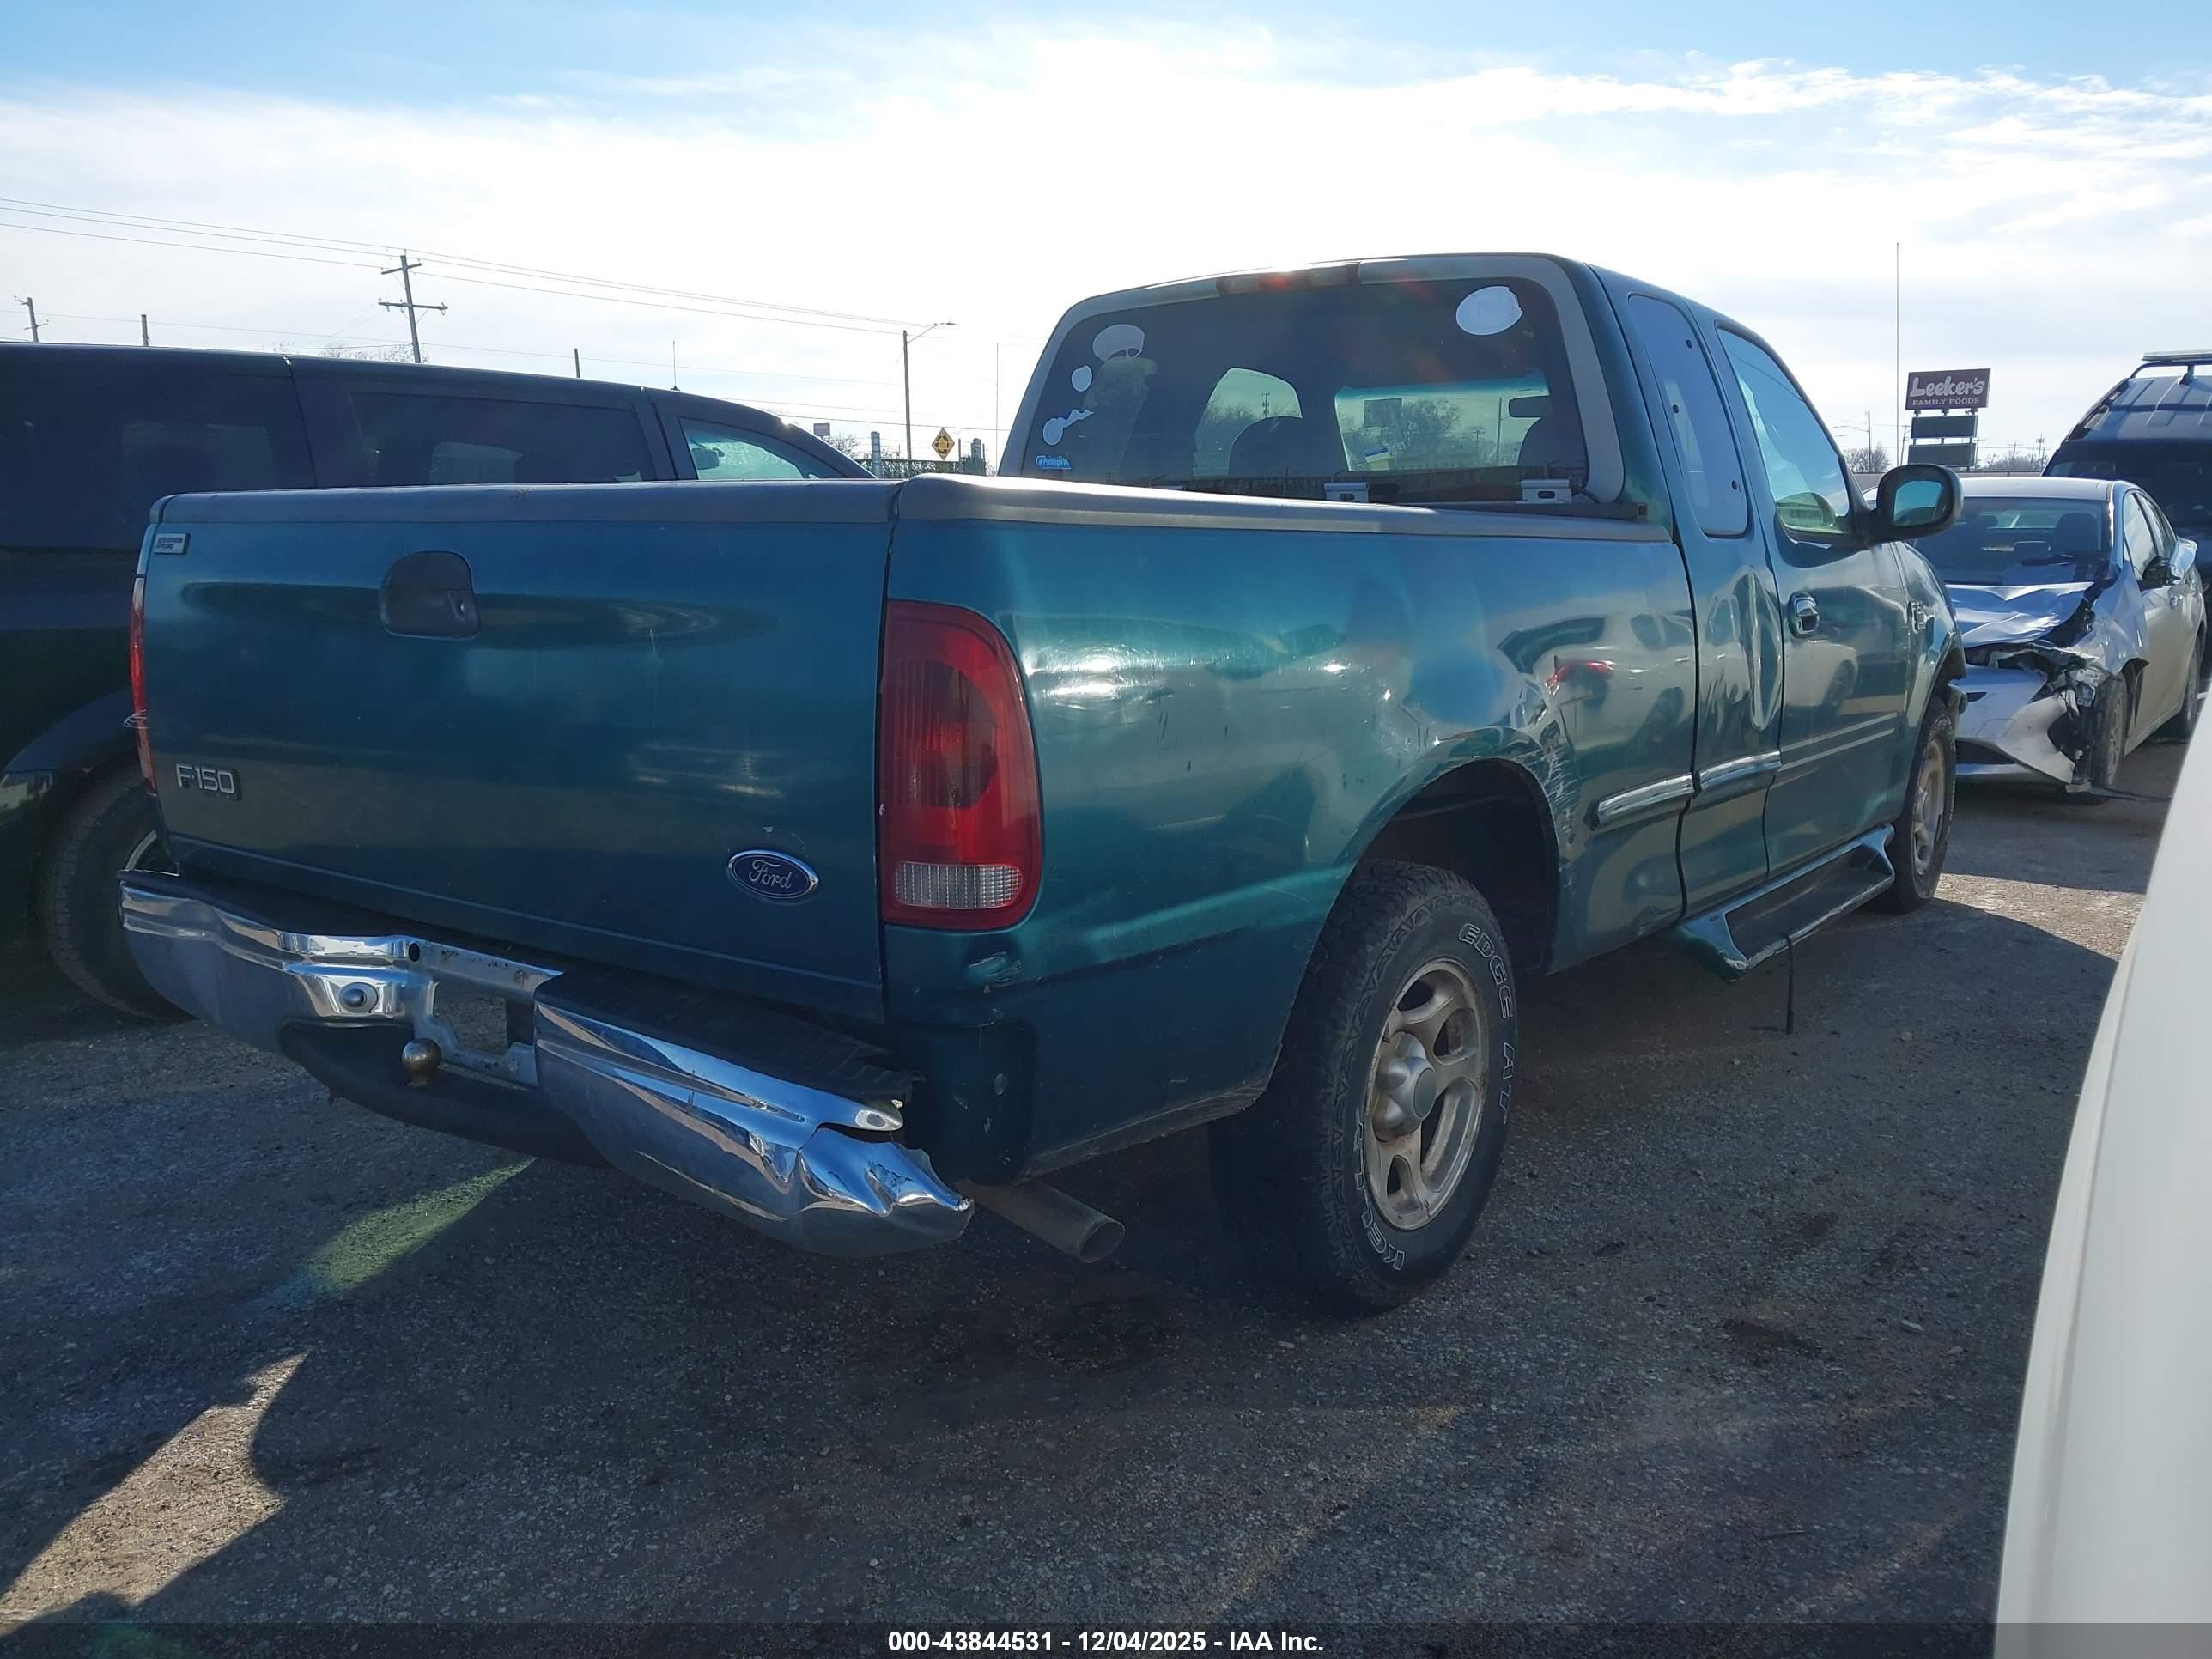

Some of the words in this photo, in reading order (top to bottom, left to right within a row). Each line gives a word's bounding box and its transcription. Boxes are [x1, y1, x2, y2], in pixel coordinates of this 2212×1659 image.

[1911, 376, 1985, 397] Leeker's
[749, 860, 792, 889] Ford
[1458, 923, 1513, 1018] EDGE
[1499, 1042, 1516, 1125] AT
